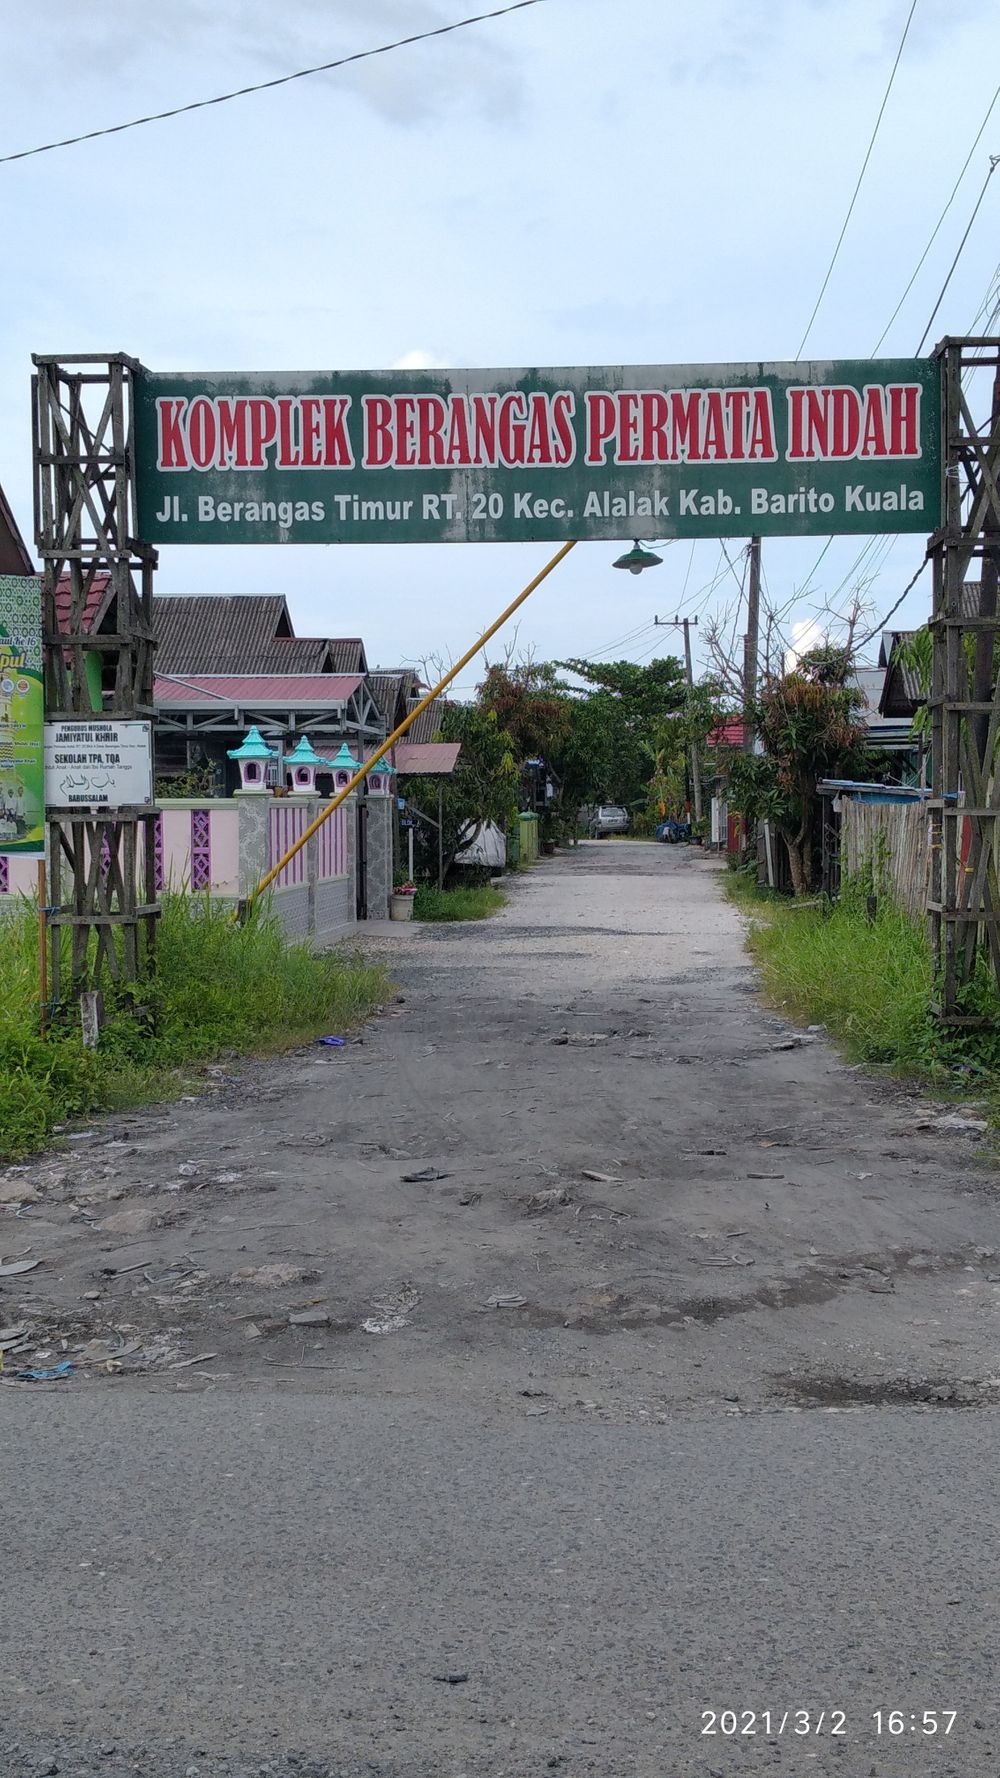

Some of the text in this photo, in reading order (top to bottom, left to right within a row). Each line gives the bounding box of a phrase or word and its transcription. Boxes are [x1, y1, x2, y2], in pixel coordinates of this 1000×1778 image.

[156, 383, 922, 472] KOMPLEK BERANGAS PERMATA INDAH
[156, 485, 924, 528] Jl. Berangas Timur RT. 20 Kec. Alalak Kab. Barito Kuala
[88, 724, 113, 732] MUSHOLA
[55, 732, 93, 743] JAMIYATUL
[54, 753, 87, 764] SEKOLAH
[105, 753, 120, 764] TQA
[68, 794, 108, 803] BABUSSALAM
